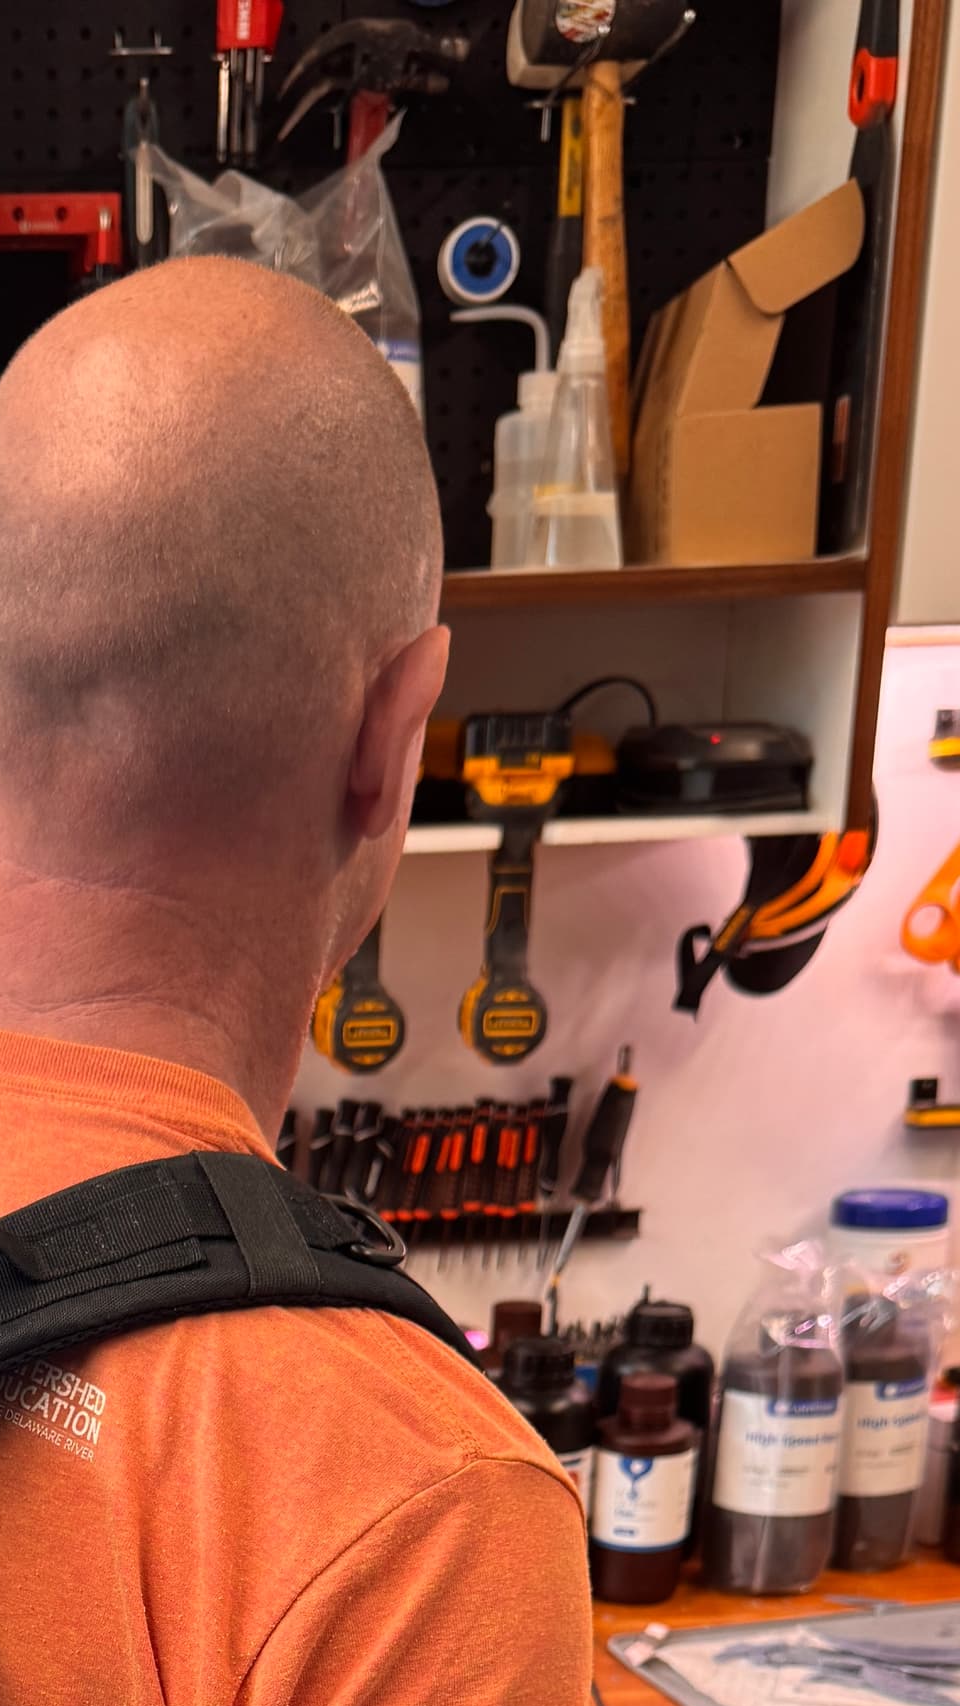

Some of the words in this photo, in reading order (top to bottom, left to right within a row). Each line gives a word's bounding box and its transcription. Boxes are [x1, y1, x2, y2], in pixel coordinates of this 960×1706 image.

[13, 1360, 106, 1416] TERSHED
[4, 1409, 62, 1447] DELAWARE
[63, 1437, 95, 1463] RIVER
[746, 1431, 779, 1447] High
